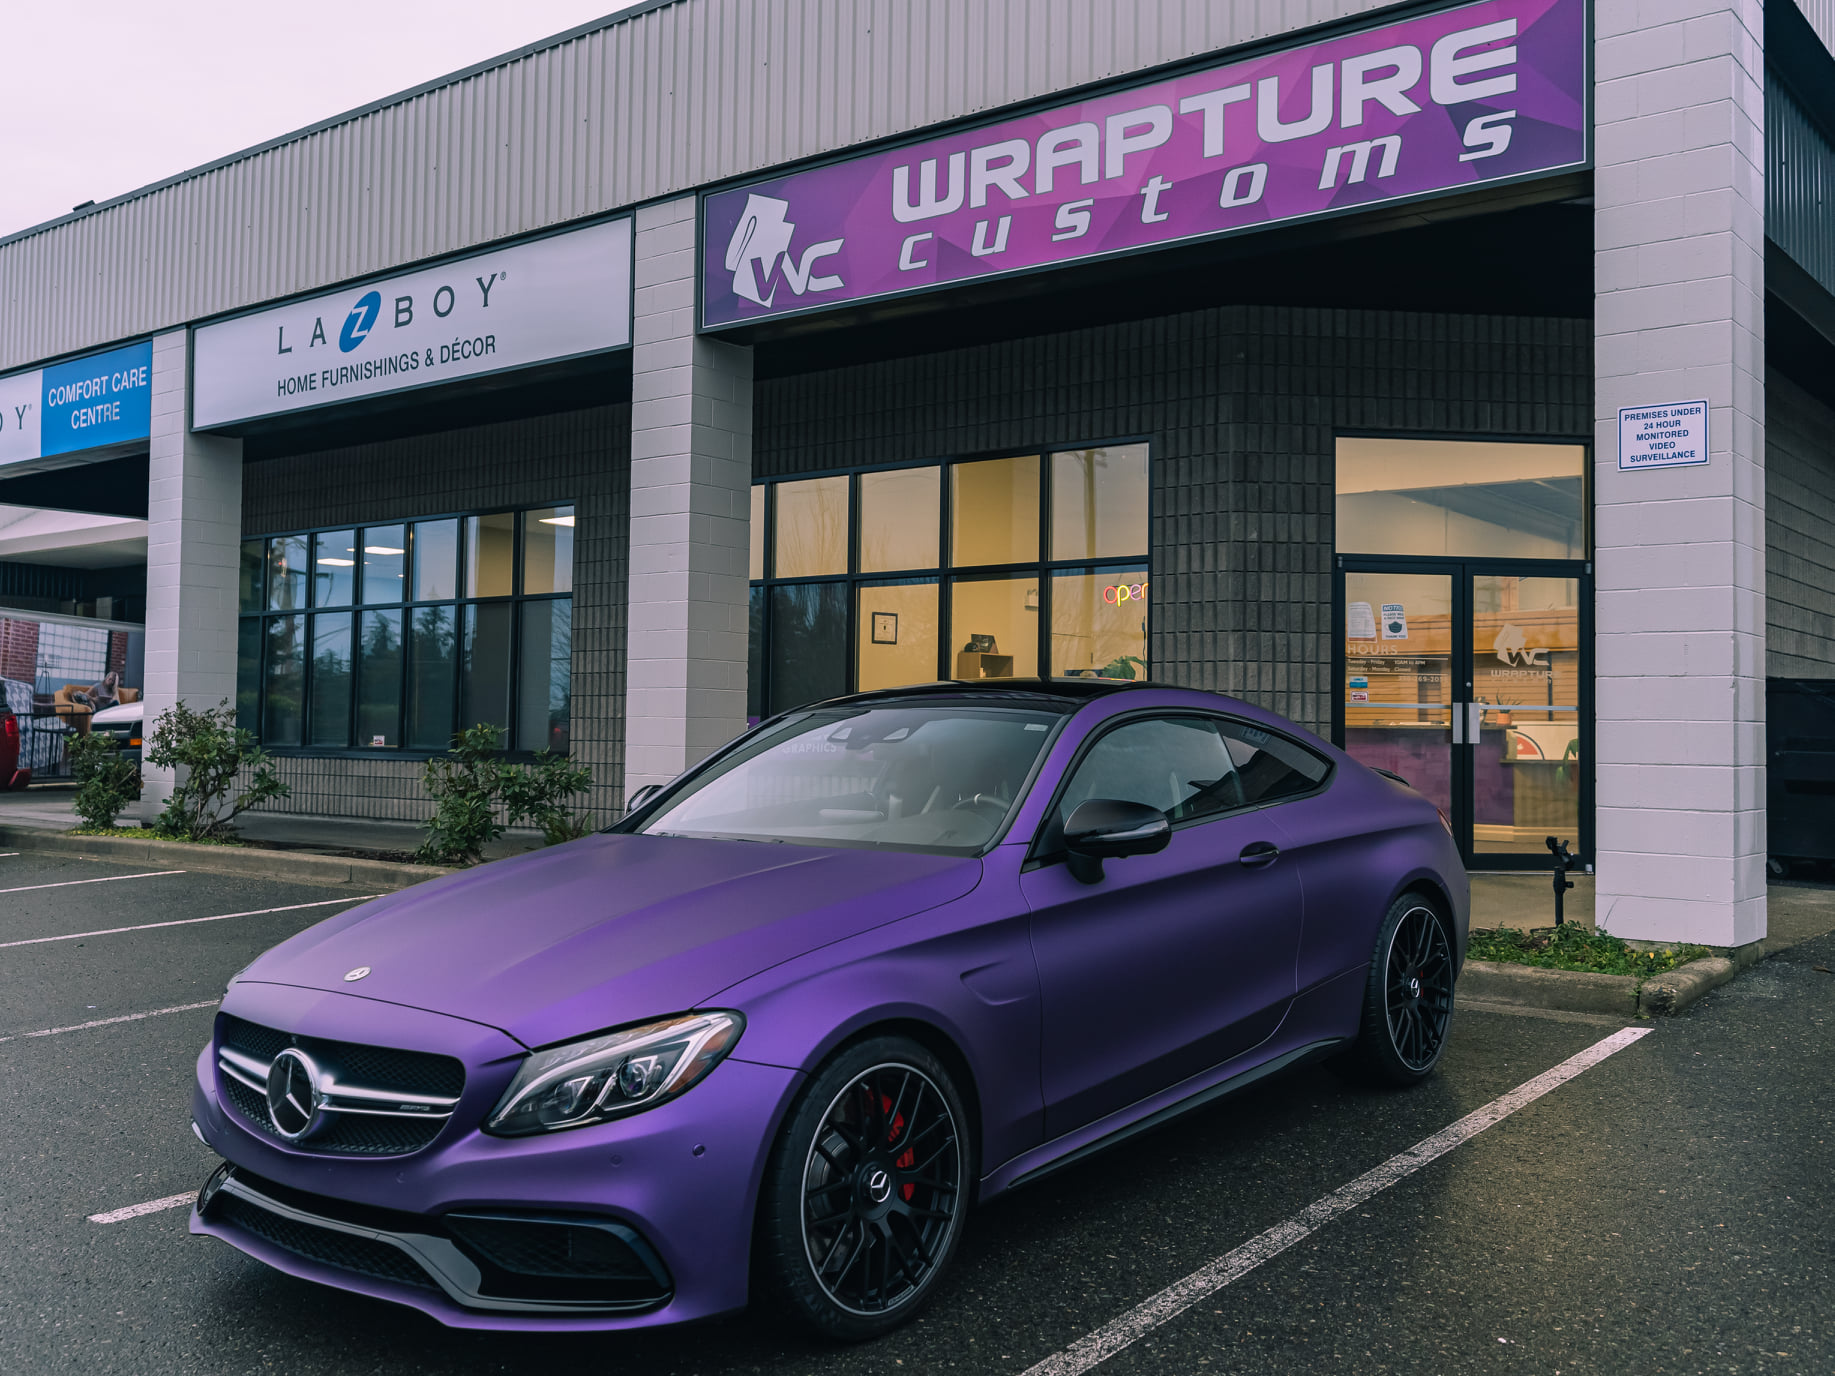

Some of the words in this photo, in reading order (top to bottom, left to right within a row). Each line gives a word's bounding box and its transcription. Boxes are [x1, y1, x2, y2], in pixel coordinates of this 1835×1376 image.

[893, 18, 1517, 223] WRAPTURE
[899, 109, 1517, 271] customs
[278, 373, 317, 396] HOME
[322, 351, 419, 388] FURNISHINGS
[424, 347, 435, 367] &
[440, 334, 496, 364] DÉCOR
[48, 375, 109, 407] COMFORT
[111, 366, 148, 393] CARE
[71, 401, 121, 429] CENTRE
[1624, 410, 1668, 421] PREMISES
[1670, 407, 1701, 417] UNDER
[1643, 422, 1654, 430] 24
[1656, 419, 1681, 429] HOUR
[1636, 429, 1689, 441] MONITORED
[1649, 441, 1676, 450] VIDEO
[1630, 450, 1696, 463] SURVEILLANCE
[1347, 644, 1398, 655] HOURS
[1491, 670, 1552, 678] WRAPTUR
